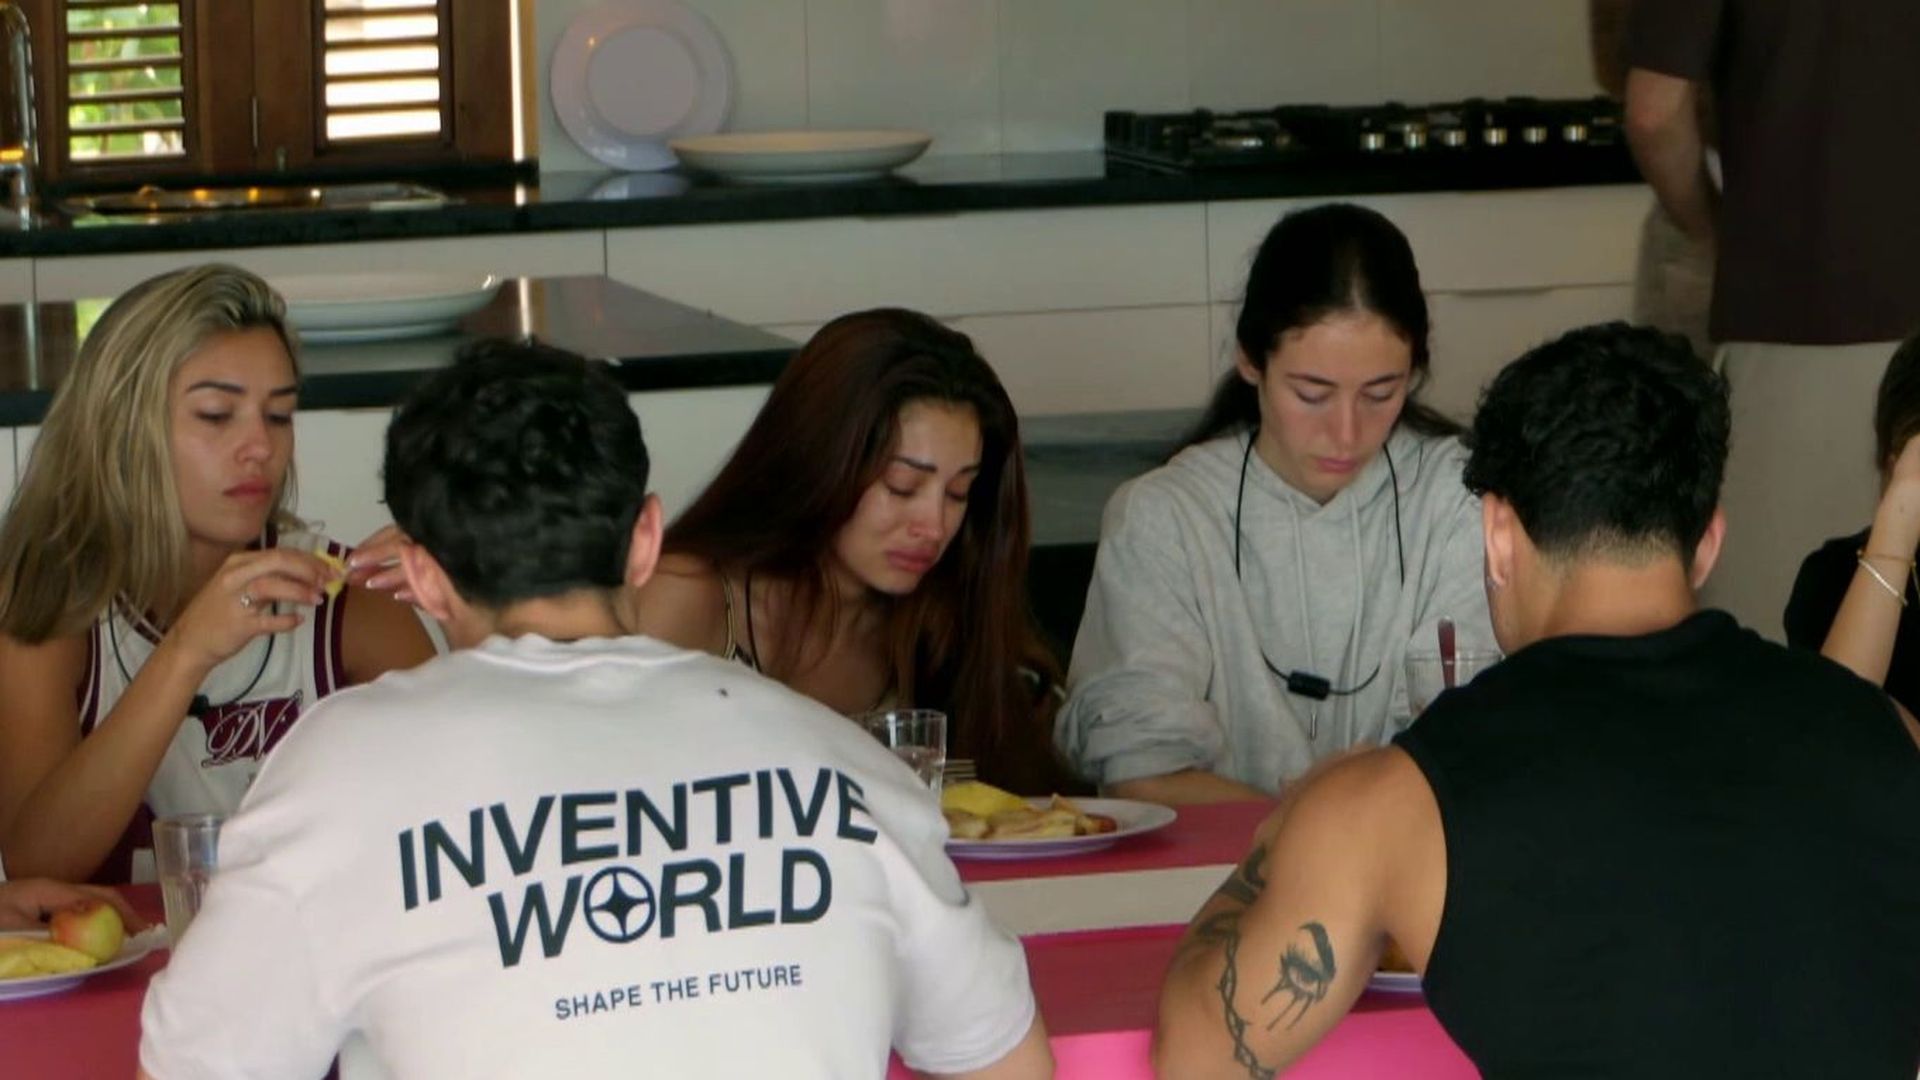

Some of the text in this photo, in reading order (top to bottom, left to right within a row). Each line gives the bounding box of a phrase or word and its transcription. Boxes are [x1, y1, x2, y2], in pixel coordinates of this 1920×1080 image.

[398, 767, 879, 912] INVENTIVE
[487, 848, 833, 968] WORLD
[555, 965, 804, 1020] SHAPE THE FUTURE
